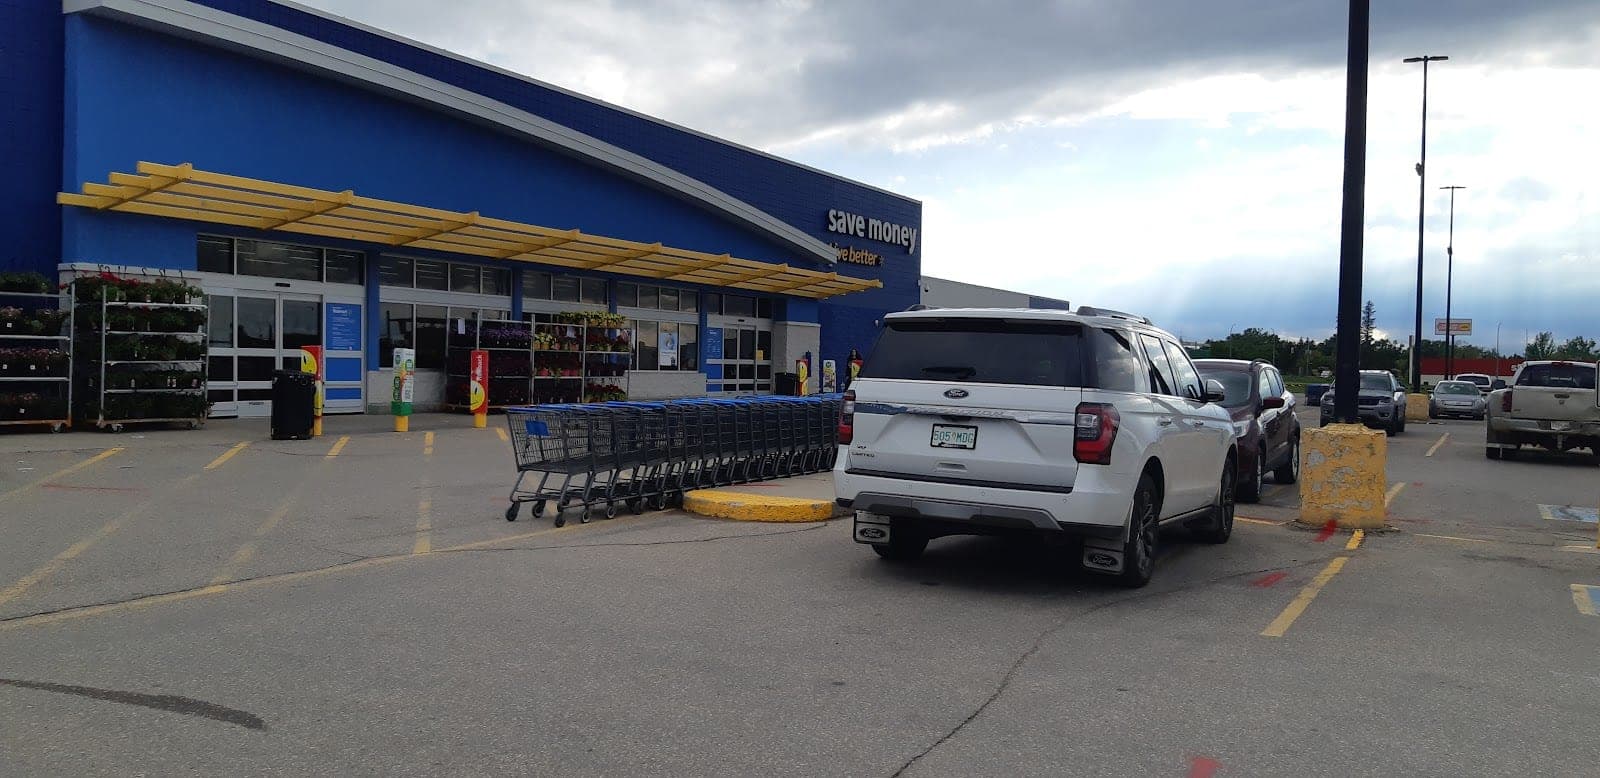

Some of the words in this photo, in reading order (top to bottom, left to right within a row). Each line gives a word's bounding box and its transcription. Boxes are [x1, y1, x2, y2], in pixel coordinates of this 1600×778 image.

[828, 208, 866, 238] save
[868, 217, 918, 256] money
[848, 246, 878, 266] better
[946, 389, 967, 399] Ford
[933, 430, 952, 442] 505
[956, 431, 974, 444] MDG
[863, 527, 883, 539] Ford
[1092, 554, 1113, 566] Ford
